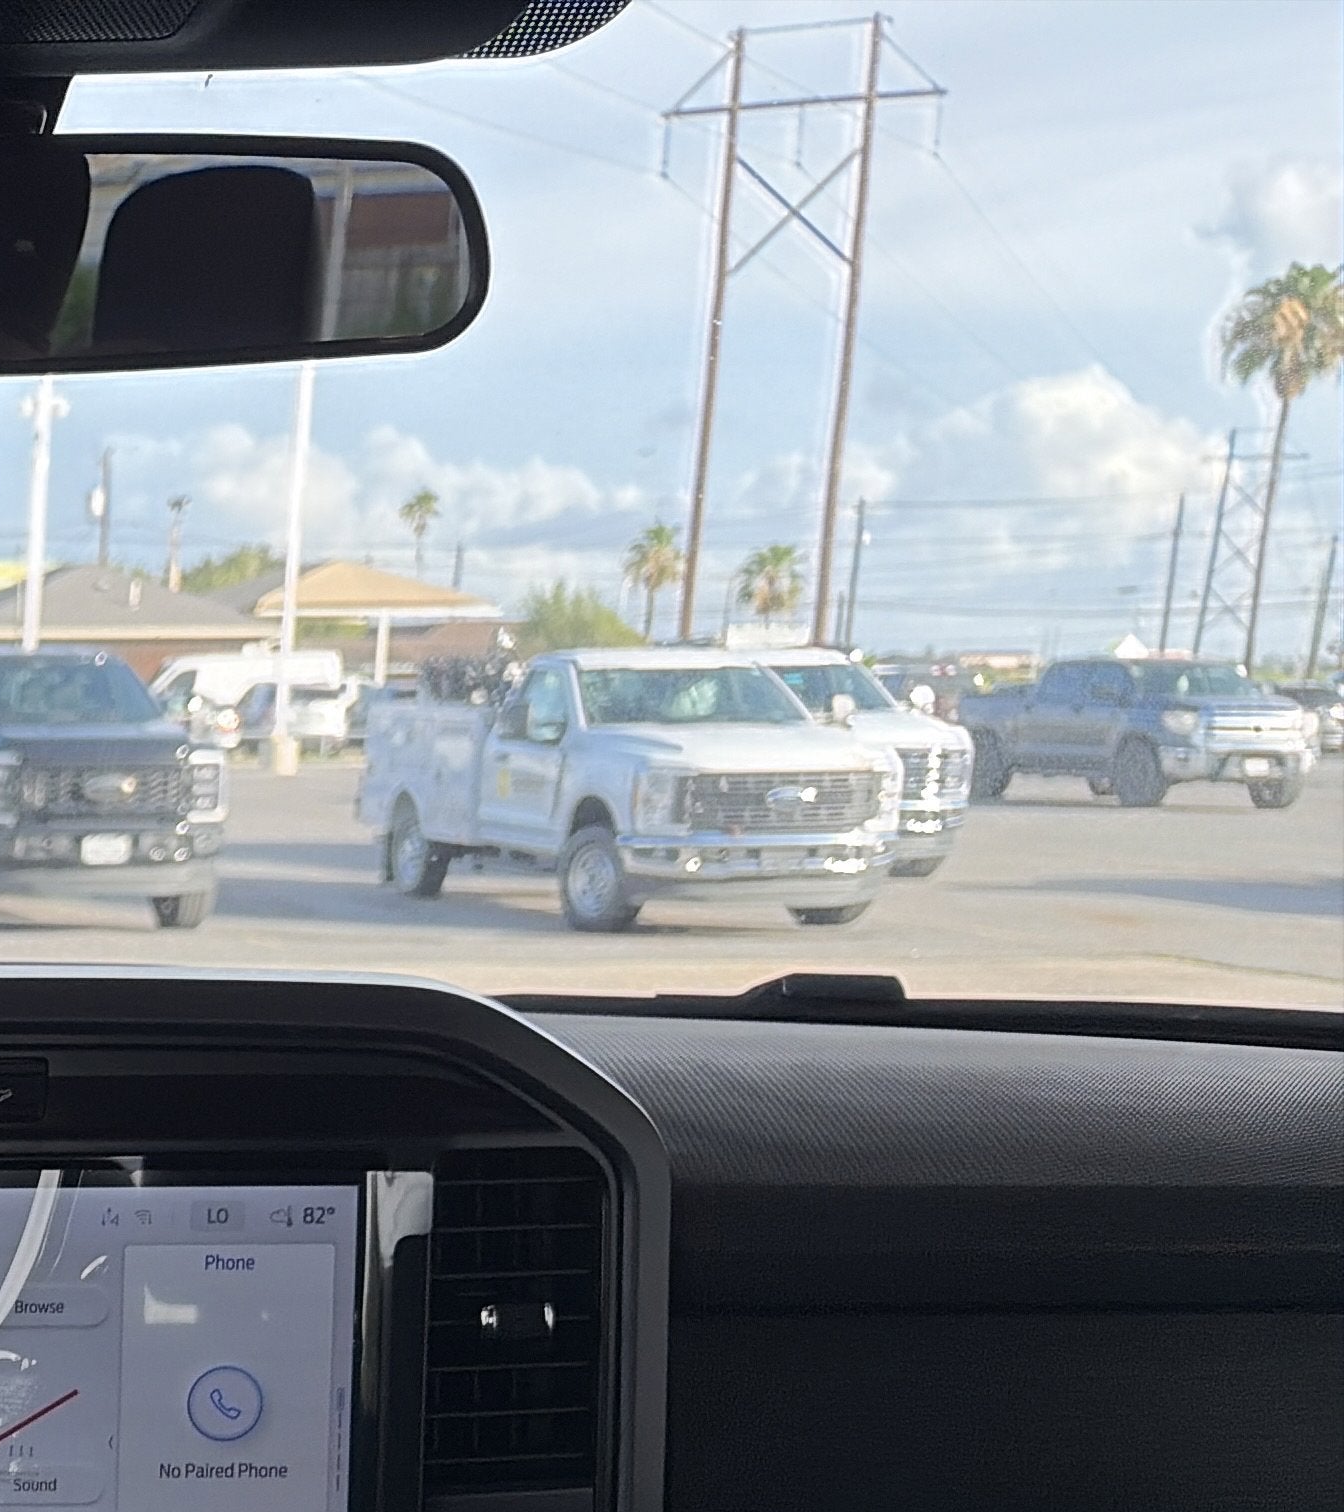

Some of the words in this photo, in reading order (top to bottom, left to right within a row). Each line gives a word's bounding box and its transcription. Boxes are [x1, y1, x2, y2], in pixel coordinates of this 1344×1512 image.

[206, 1208, 229, 1224] LO
[302, 1207, 336, 1225] 82°
[204, 1255, 255, 1271] Phone
[14, 1300, 64, 1315] Browse
[159, 1464, 182, 1479] No
[184, 1463, 234, 1479] Paired
[237, 1463, 288, 1479] Phone
[13, 1478, 57, 1493] Sound
